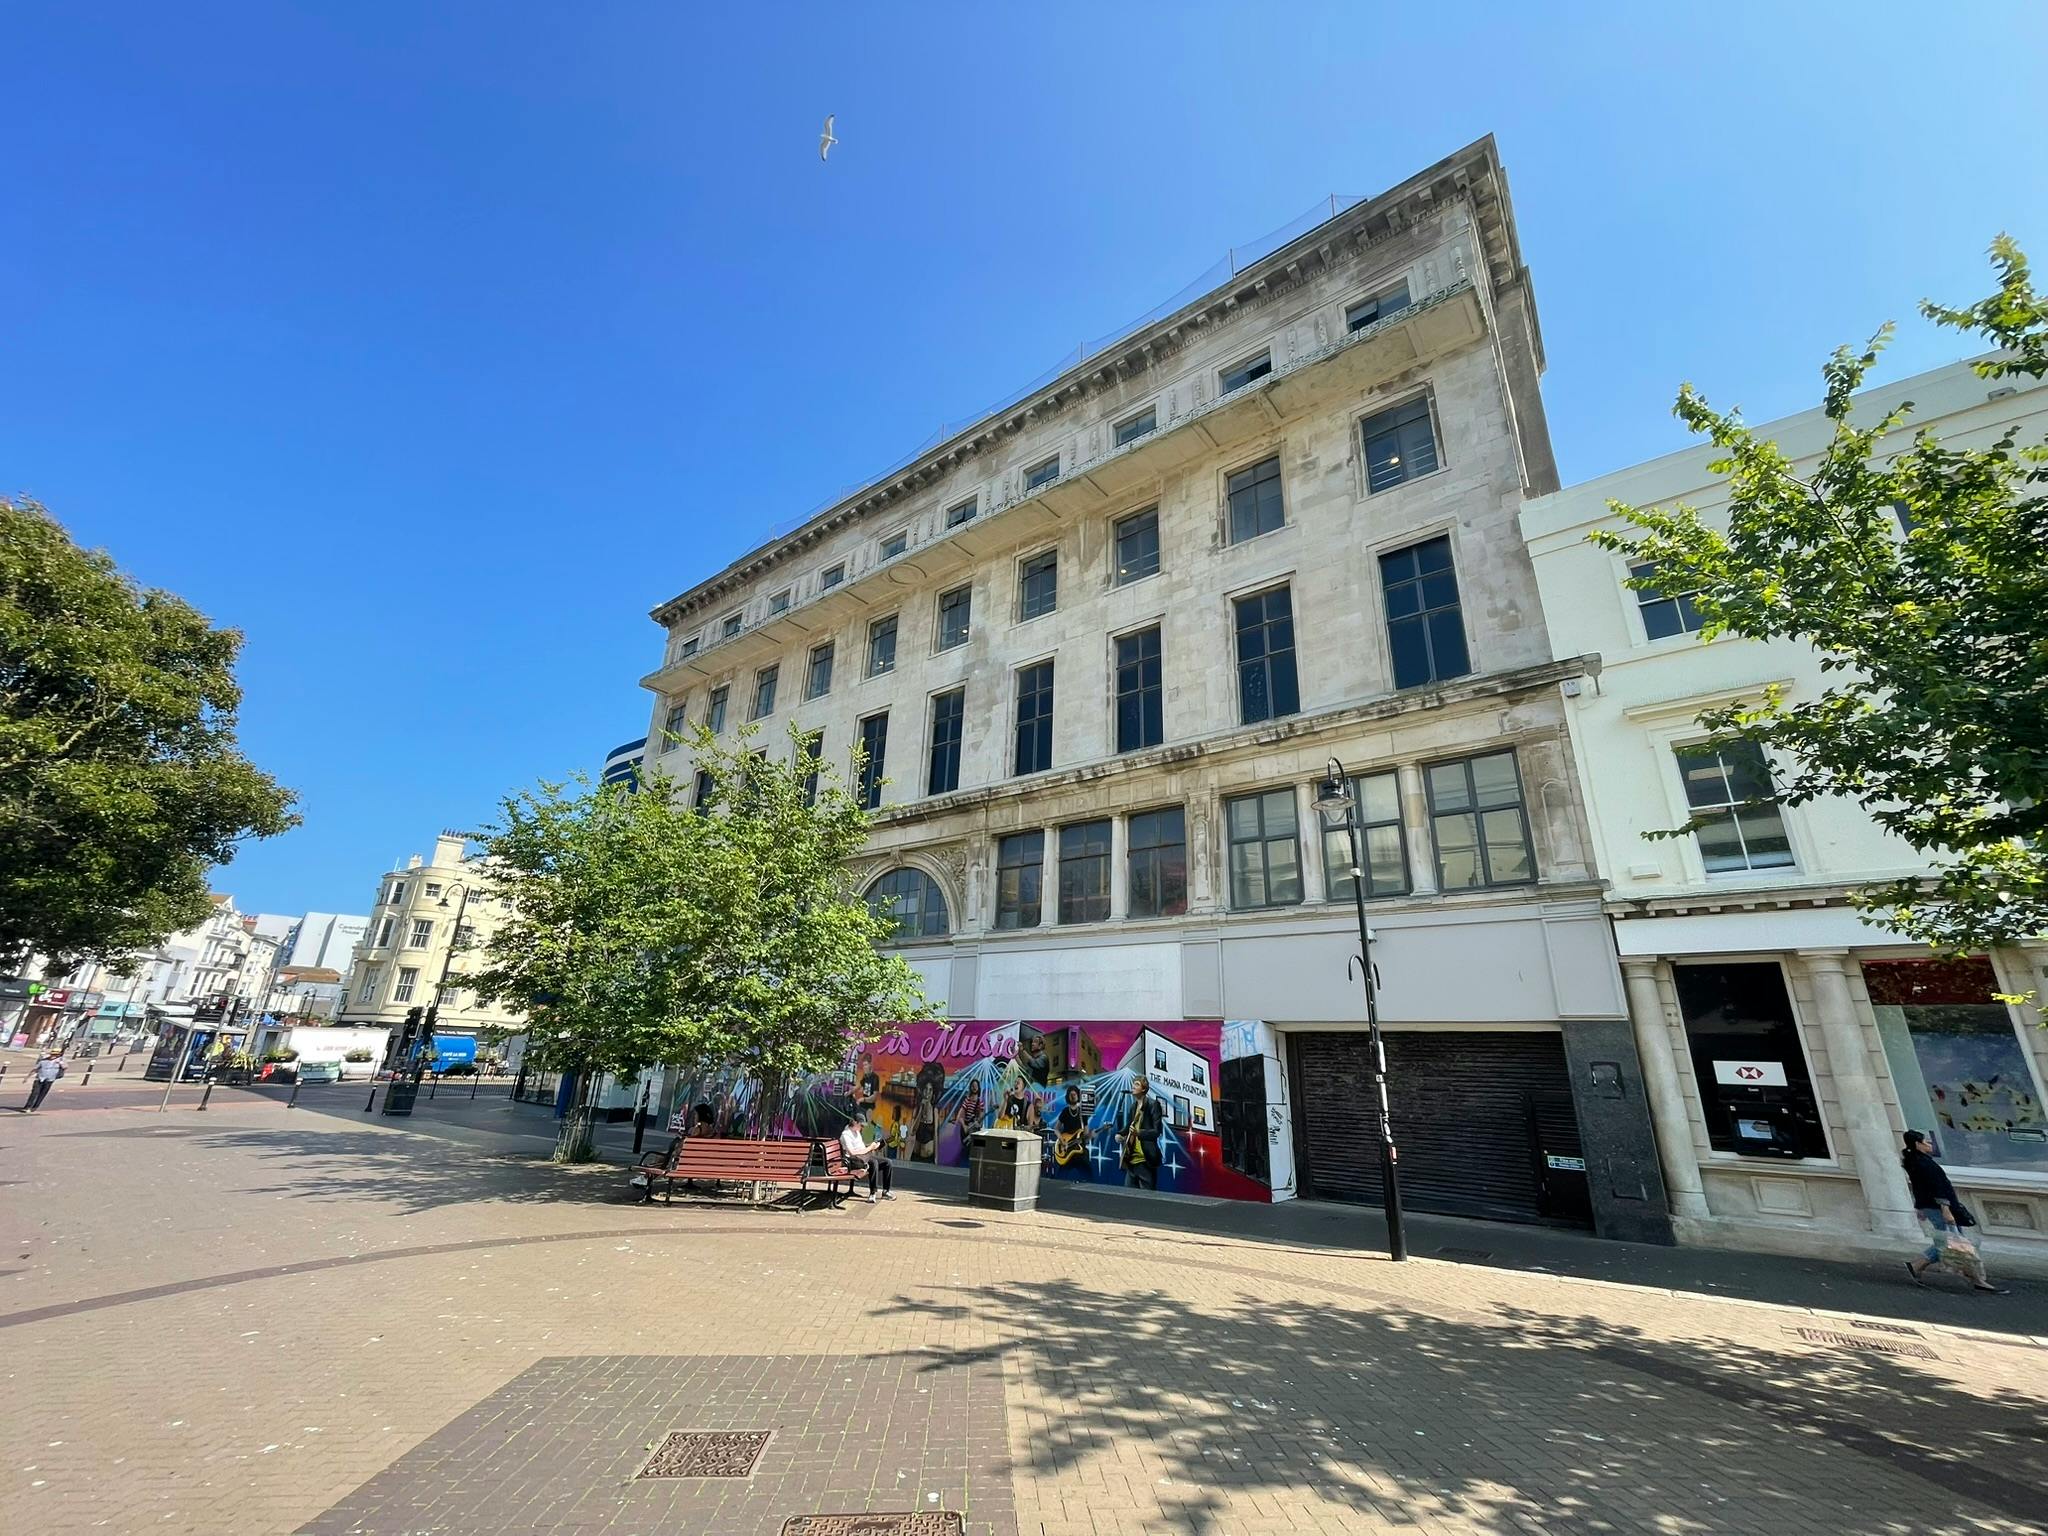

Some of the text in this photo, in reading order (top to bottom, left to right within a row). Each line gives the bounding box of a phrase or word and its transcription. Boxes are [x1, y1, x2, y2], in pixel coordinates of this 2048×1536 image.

[877, 1030, 911, 1057] is
[920, 1022, 1020, 1064] Music
[1150, 1073, 1208, 1098] THE MARINA FOUNTAIN
